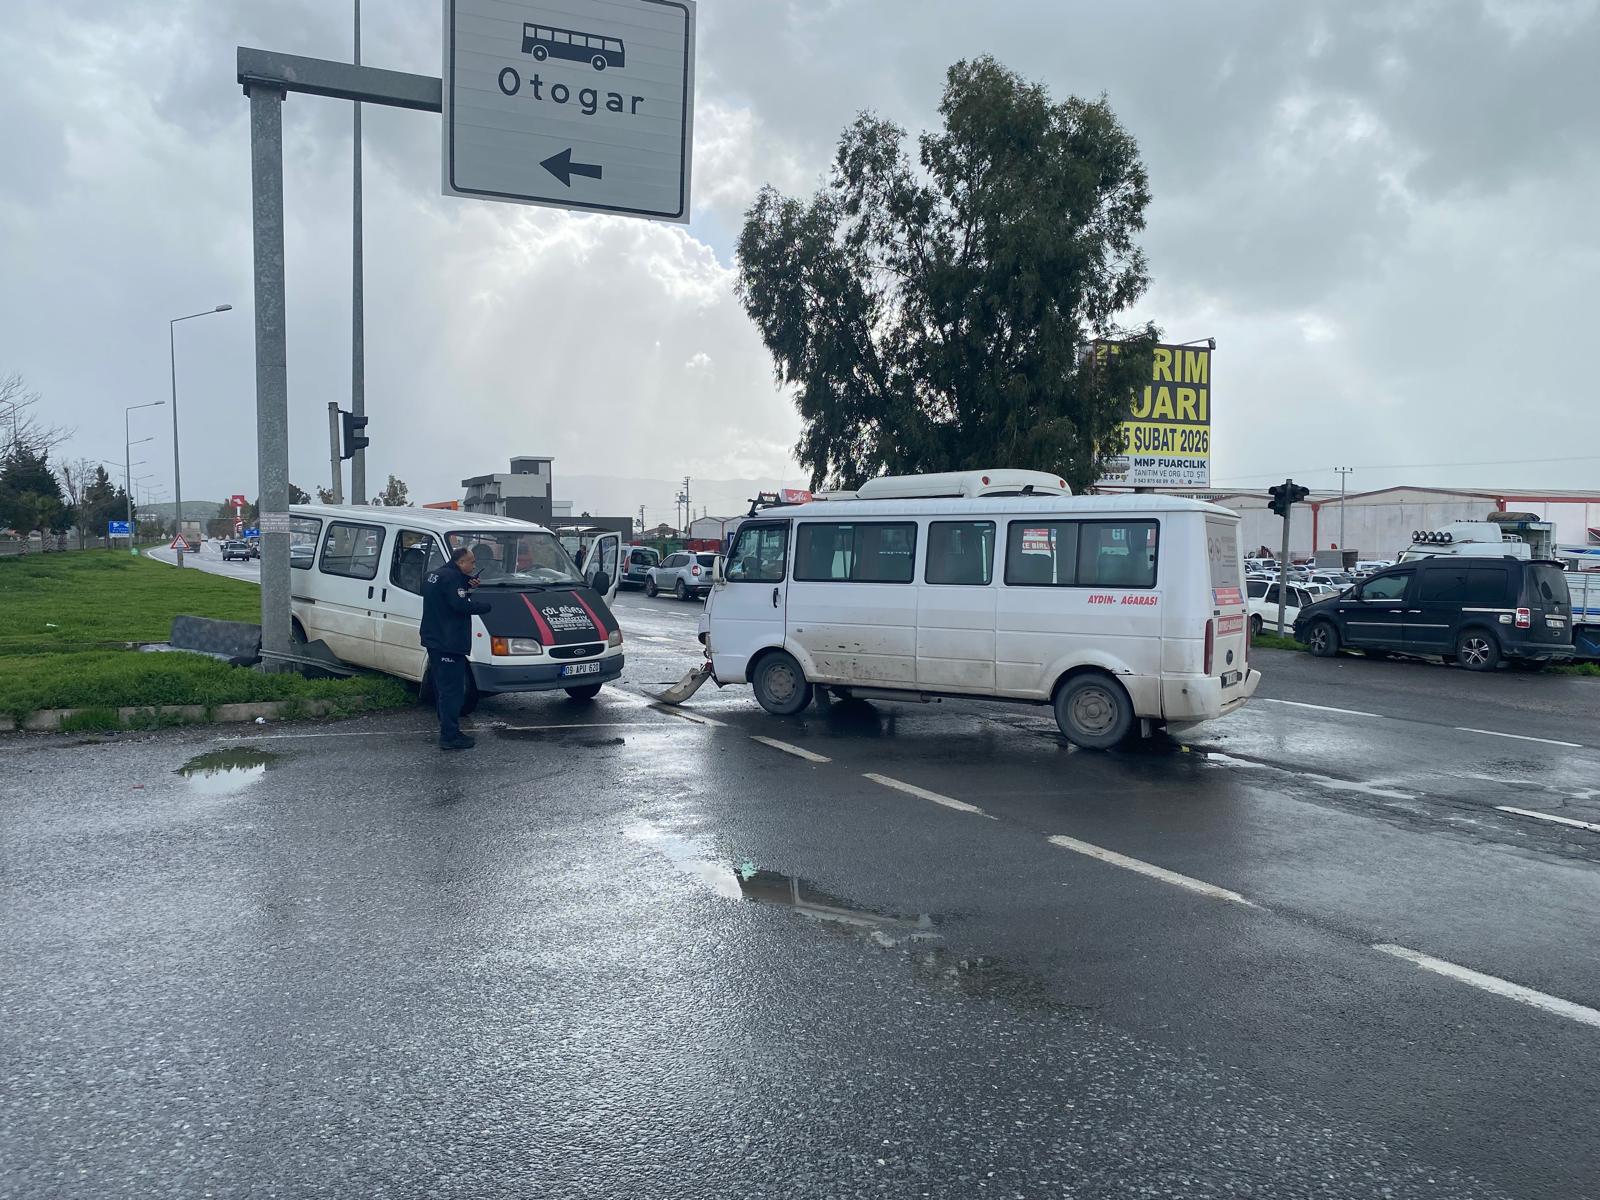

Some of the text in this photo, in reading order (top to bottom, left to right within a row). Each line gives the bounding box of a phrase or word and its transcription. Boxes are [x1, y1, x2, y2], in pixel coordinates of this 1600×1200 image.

[498, 67, 644, 115] Otogar
[1152, 348, 1208, 384] RIM
[1130, 385, 1207, 421] UARI
[1134, 426, 1177, 452] ŞUBAT
[1180, 429, 1209, 453] 2026
[1134, 458, 1156, 468] MNP
[1158, 459, 1206, 469] FUARCILIK
[1121, 594, 1158, 606] AĞARASI
[565, 662, 599, 675] 09 APU 620
